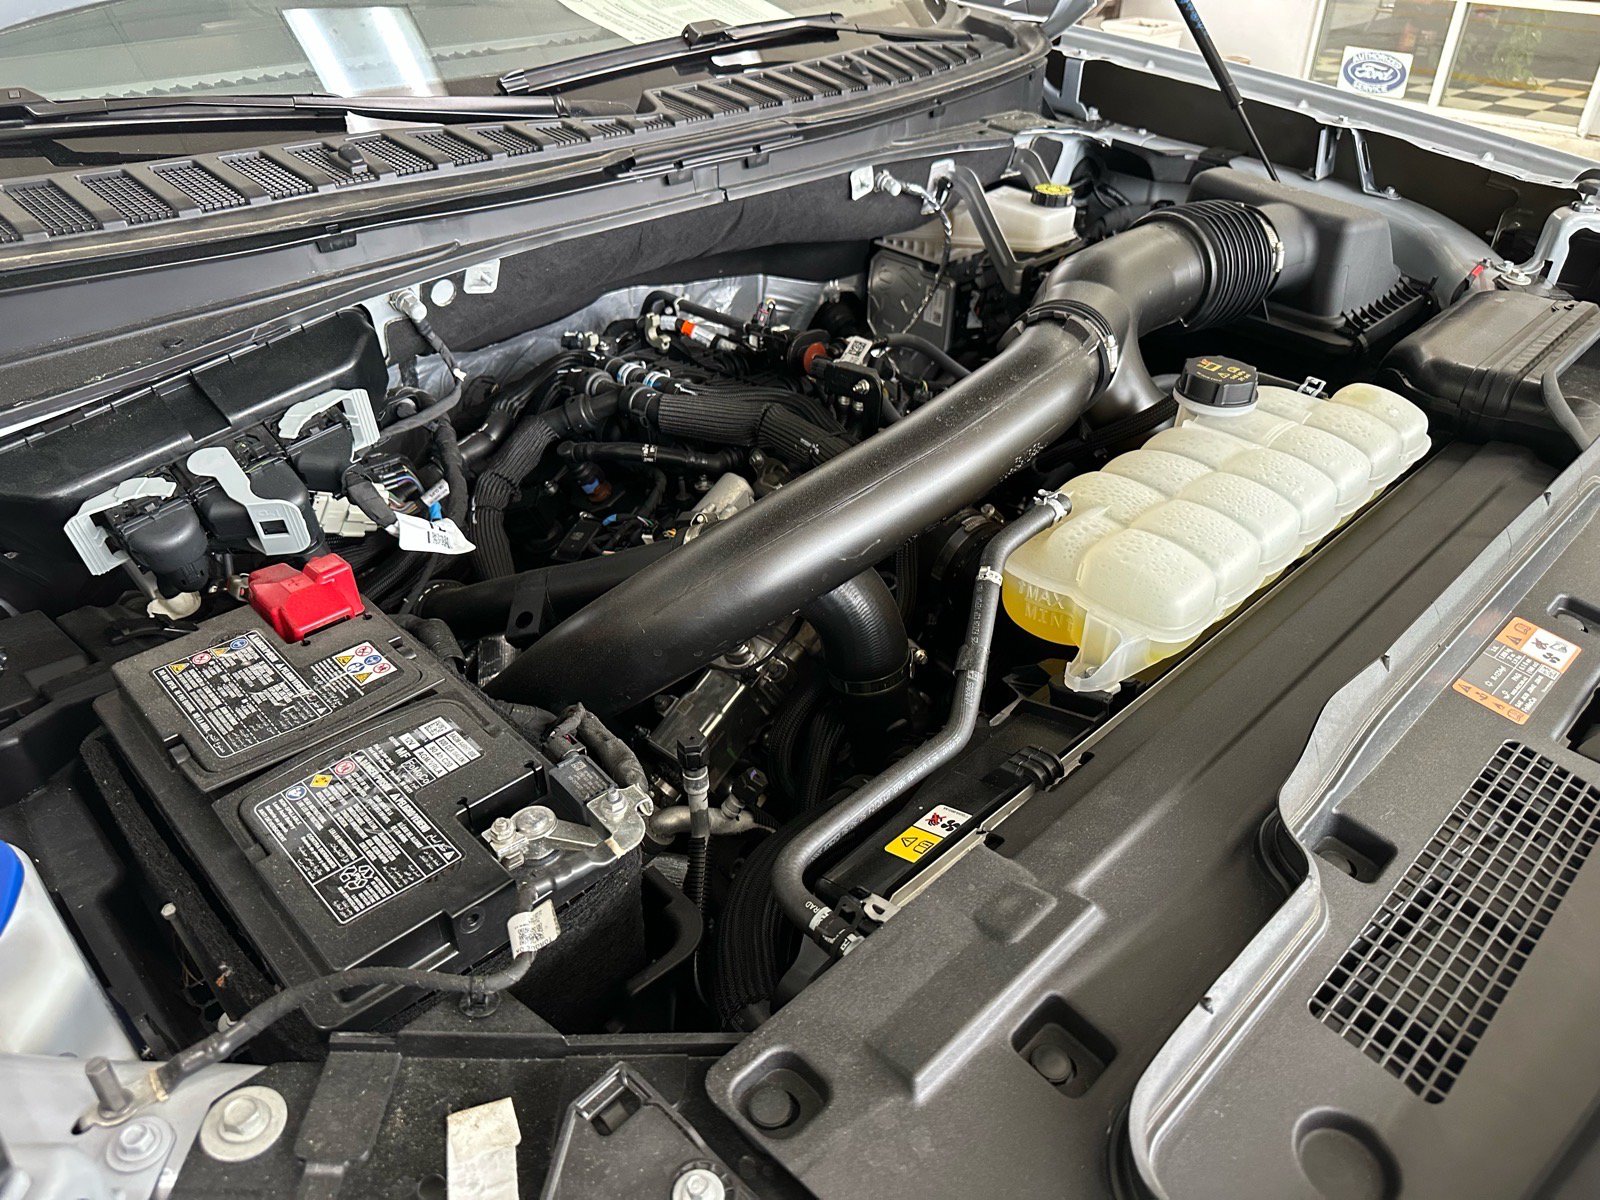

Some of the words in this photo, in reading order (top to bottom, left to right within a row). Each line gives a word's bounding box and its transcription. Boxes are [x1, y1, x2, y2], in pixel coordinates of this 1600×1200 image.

[1354, 62, 1394, 81] Ford
[1026, 585, 1065, 610] MAX
[1024, 601, 1064, 627] MIN
[403, 736, 416, 746] 12V
[393, 746, 412, 760] MF
[404, 759, 432, 784] FoMoCo
[804, 899, 820, 914] RAD
